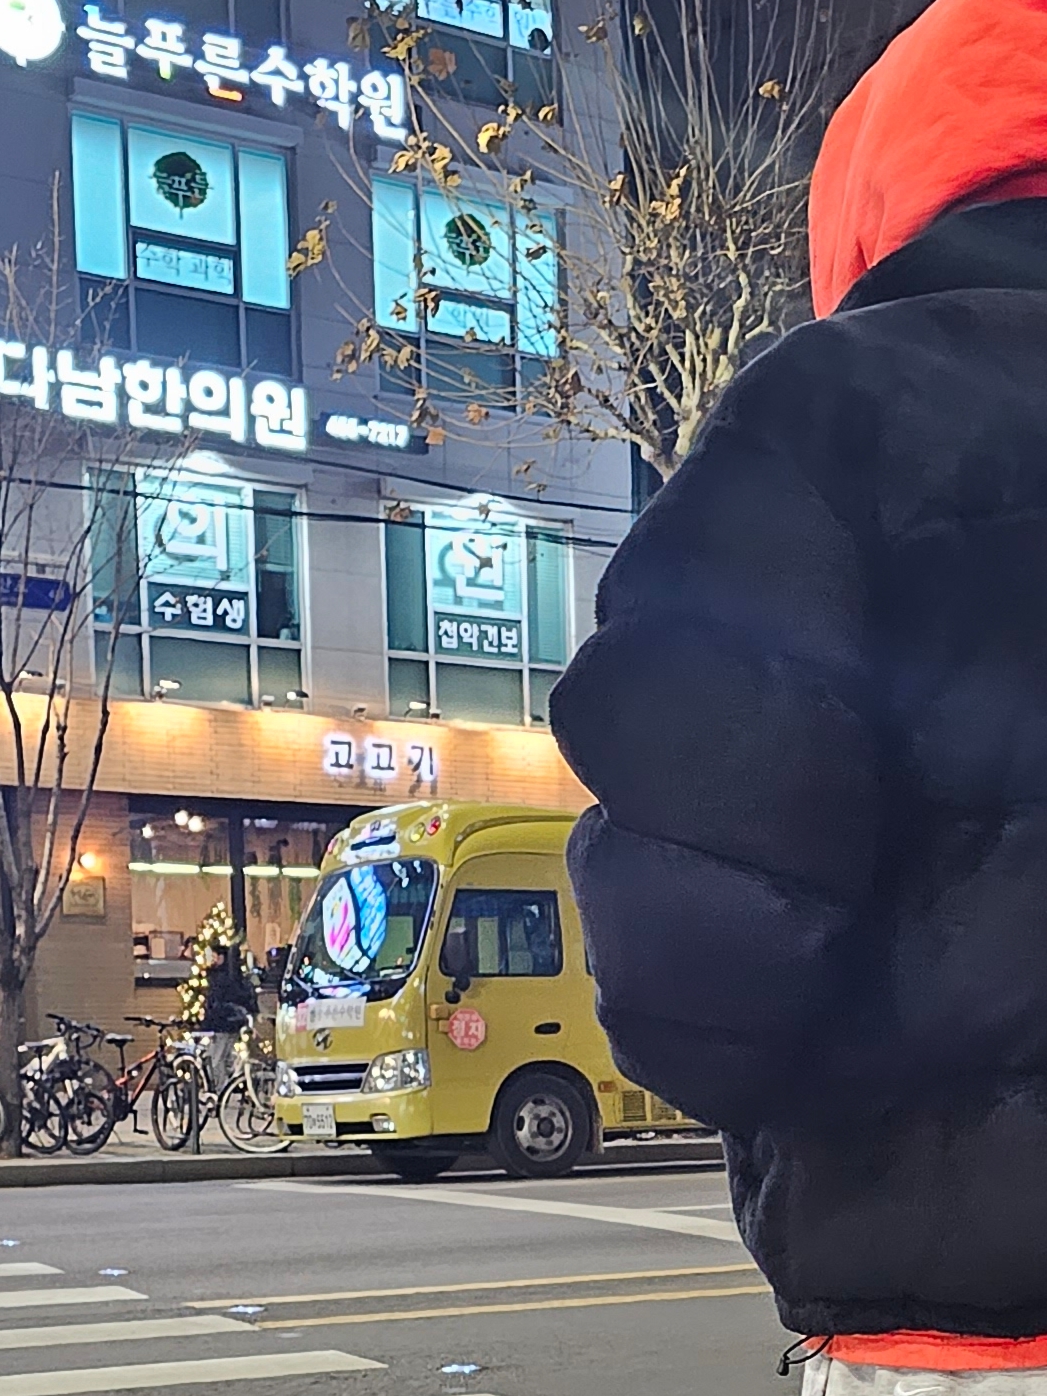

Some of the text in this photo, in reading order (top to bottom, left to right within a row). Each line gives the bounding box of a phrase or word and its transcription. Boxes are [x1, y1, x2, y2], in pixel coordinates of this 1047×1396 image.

[76, 4, 410, 146] 늘푸른수학원
[0, 338, 308, 452] 다남한의원
[153, 591, 246, 630] 수험생
[438, 619, 518, 654] 첩약건보
[330, 739, 434, 776] 고고기
